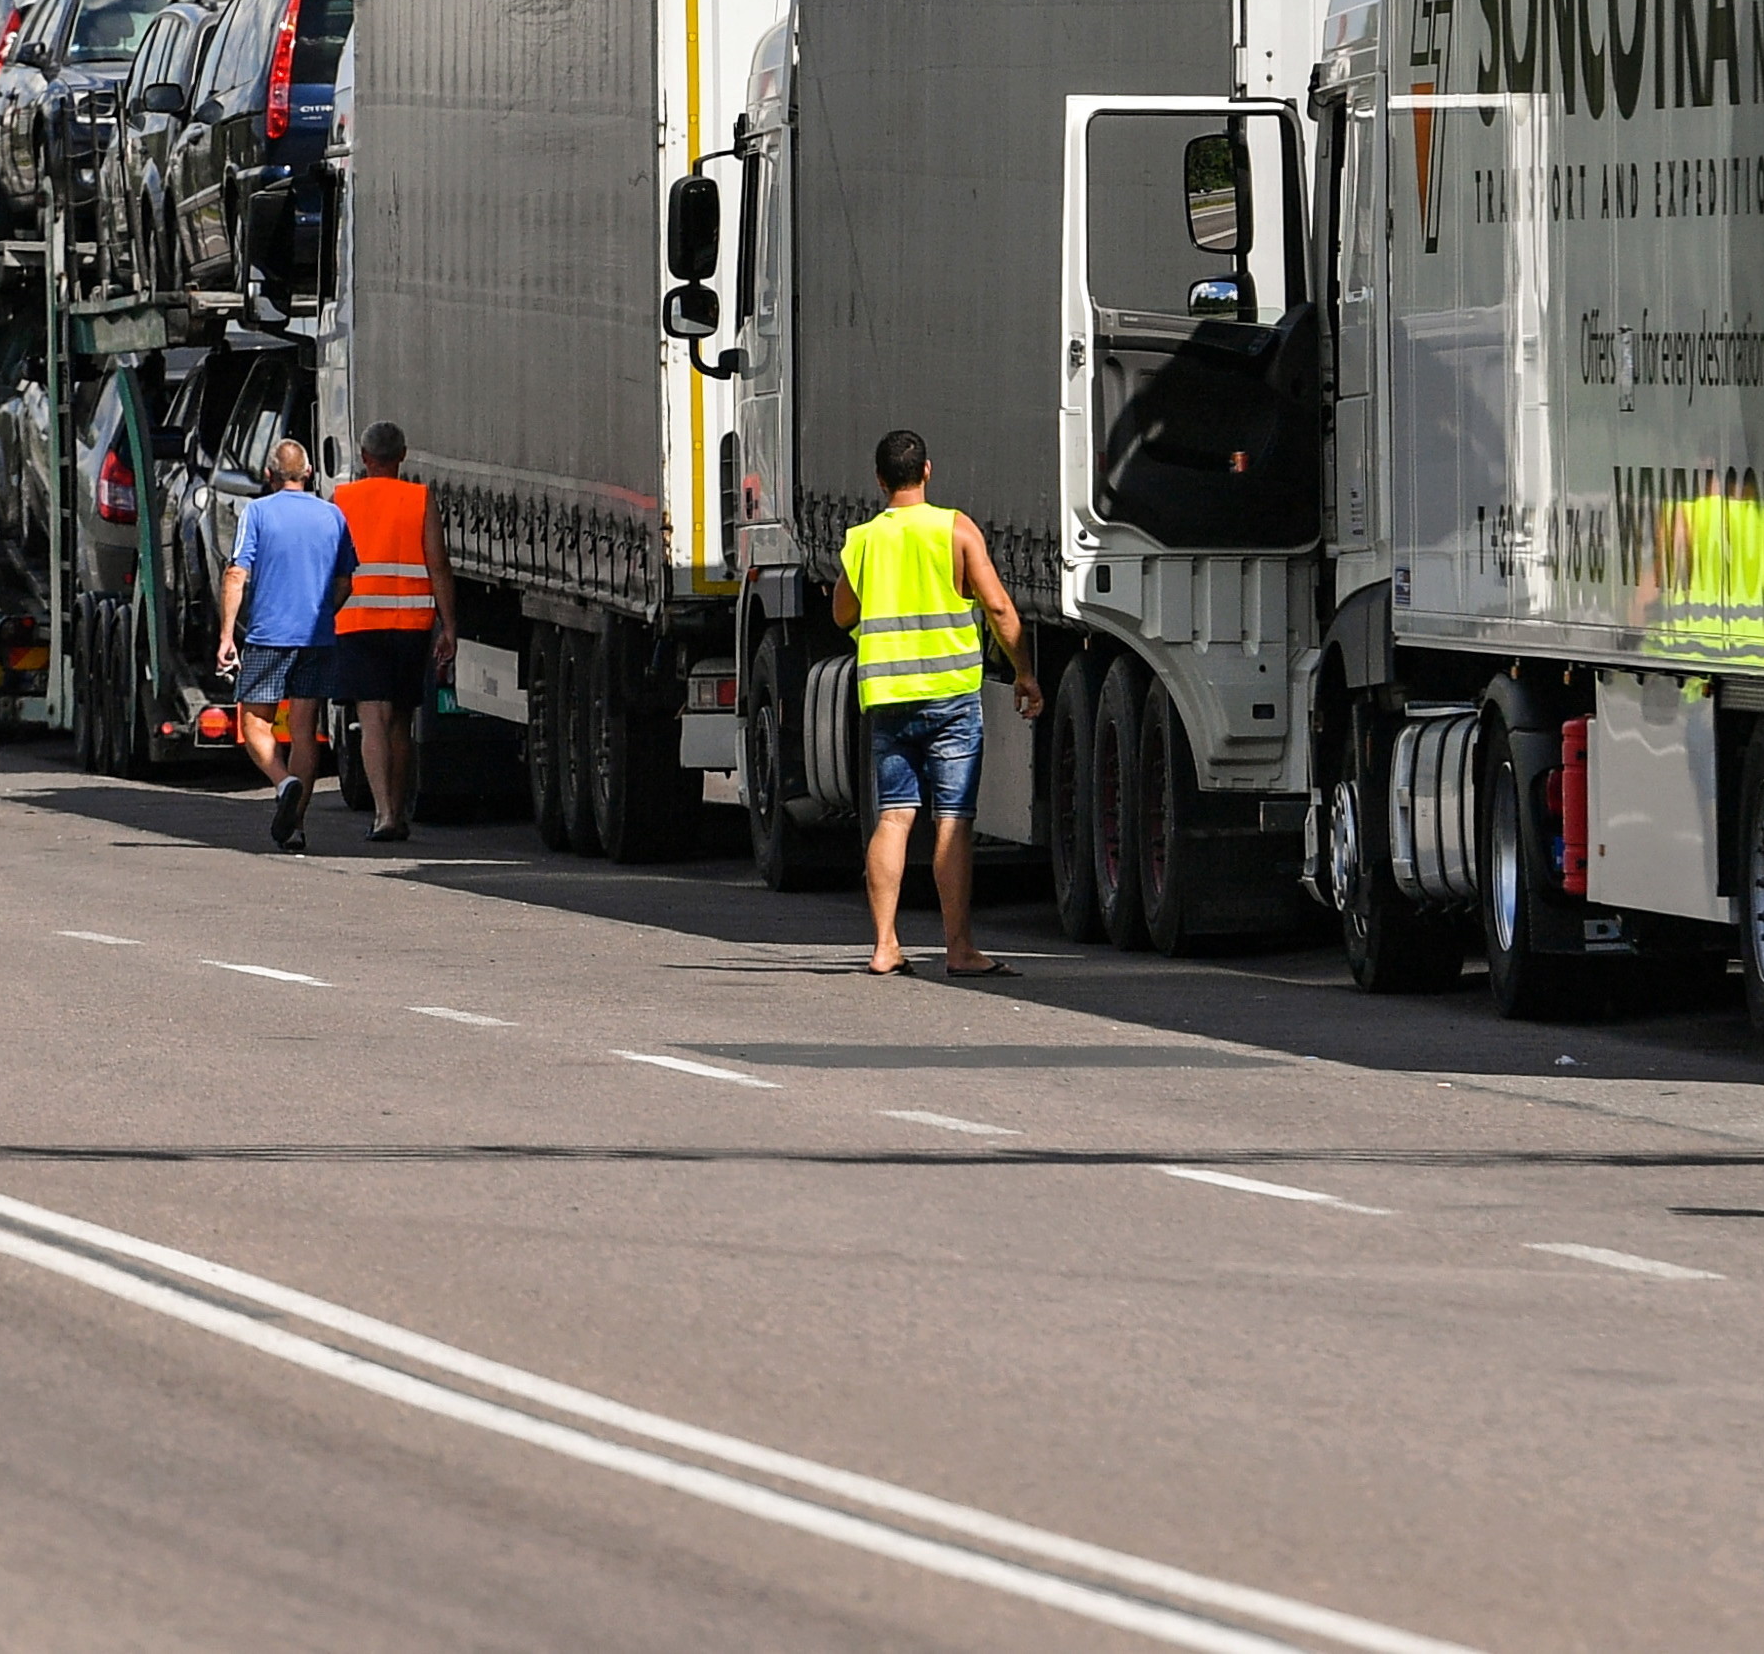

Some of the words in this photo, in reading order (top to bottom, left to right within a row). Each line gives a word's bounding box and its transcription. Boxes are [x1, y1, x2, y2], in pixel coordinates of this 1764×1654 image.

[1601, 162, 1639, 219] AND
[1580, 308, 1616, 385] Offers
[1661, 332, 1696, 407] every
